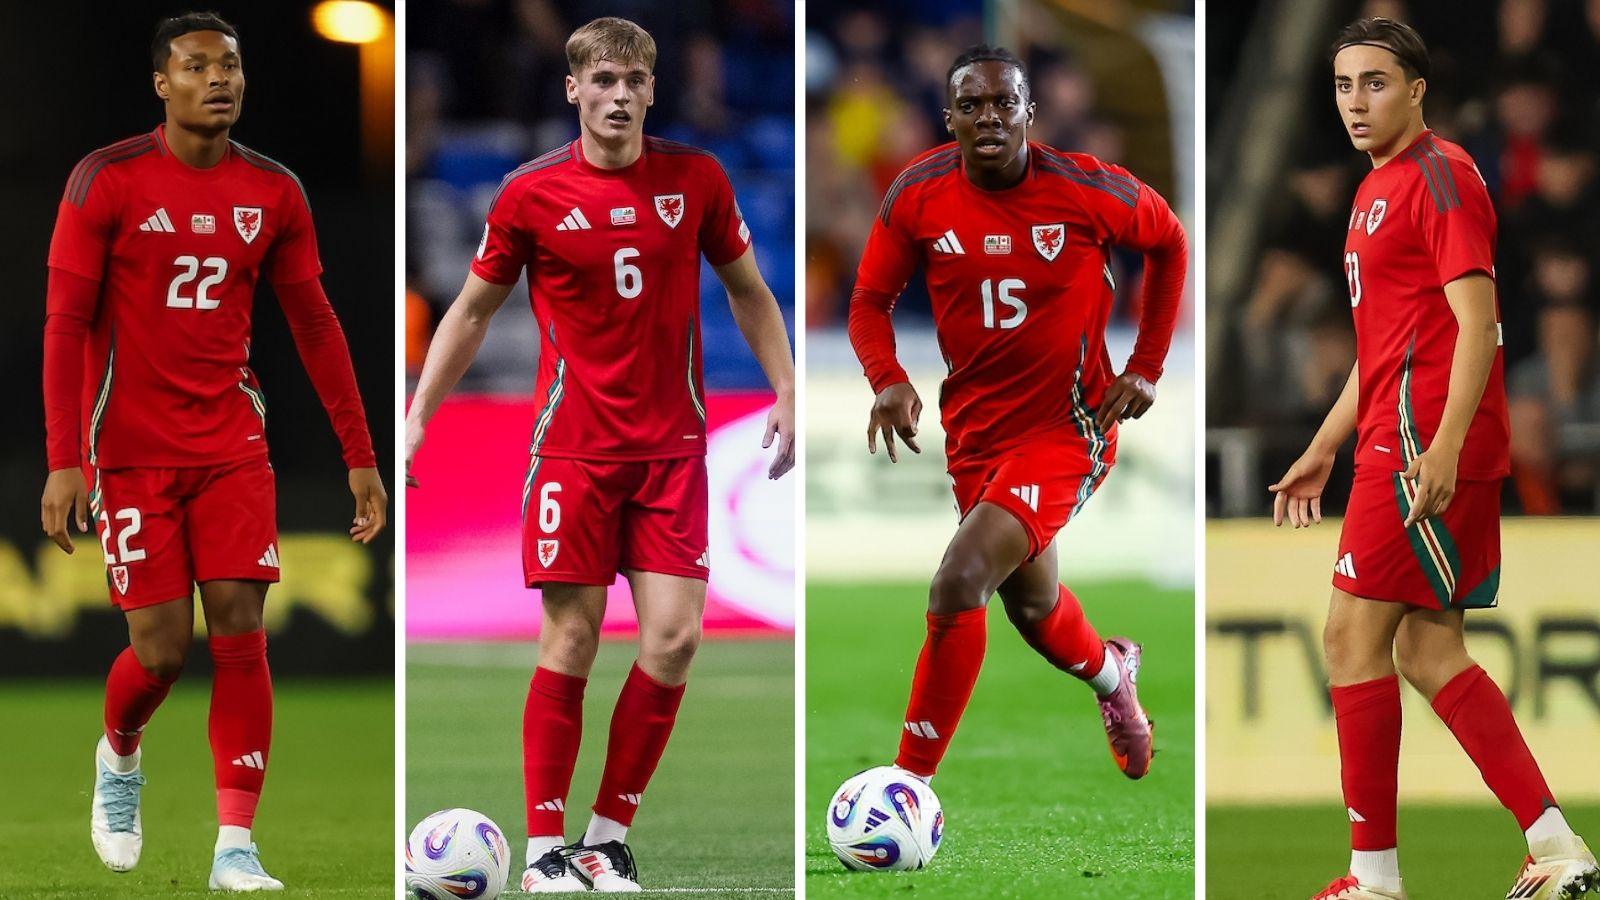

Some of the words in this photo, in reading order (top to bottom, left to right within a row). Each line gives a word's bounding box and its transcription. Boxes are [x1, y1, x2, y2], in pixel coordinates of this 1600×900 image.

[166, 255, 228, 310] 22
[613, 247, 643, 299] 6
[980, 278, 1028, 329] 15
[538, 482, 562, 534] 6
[99, 507, 146, 565] 22
